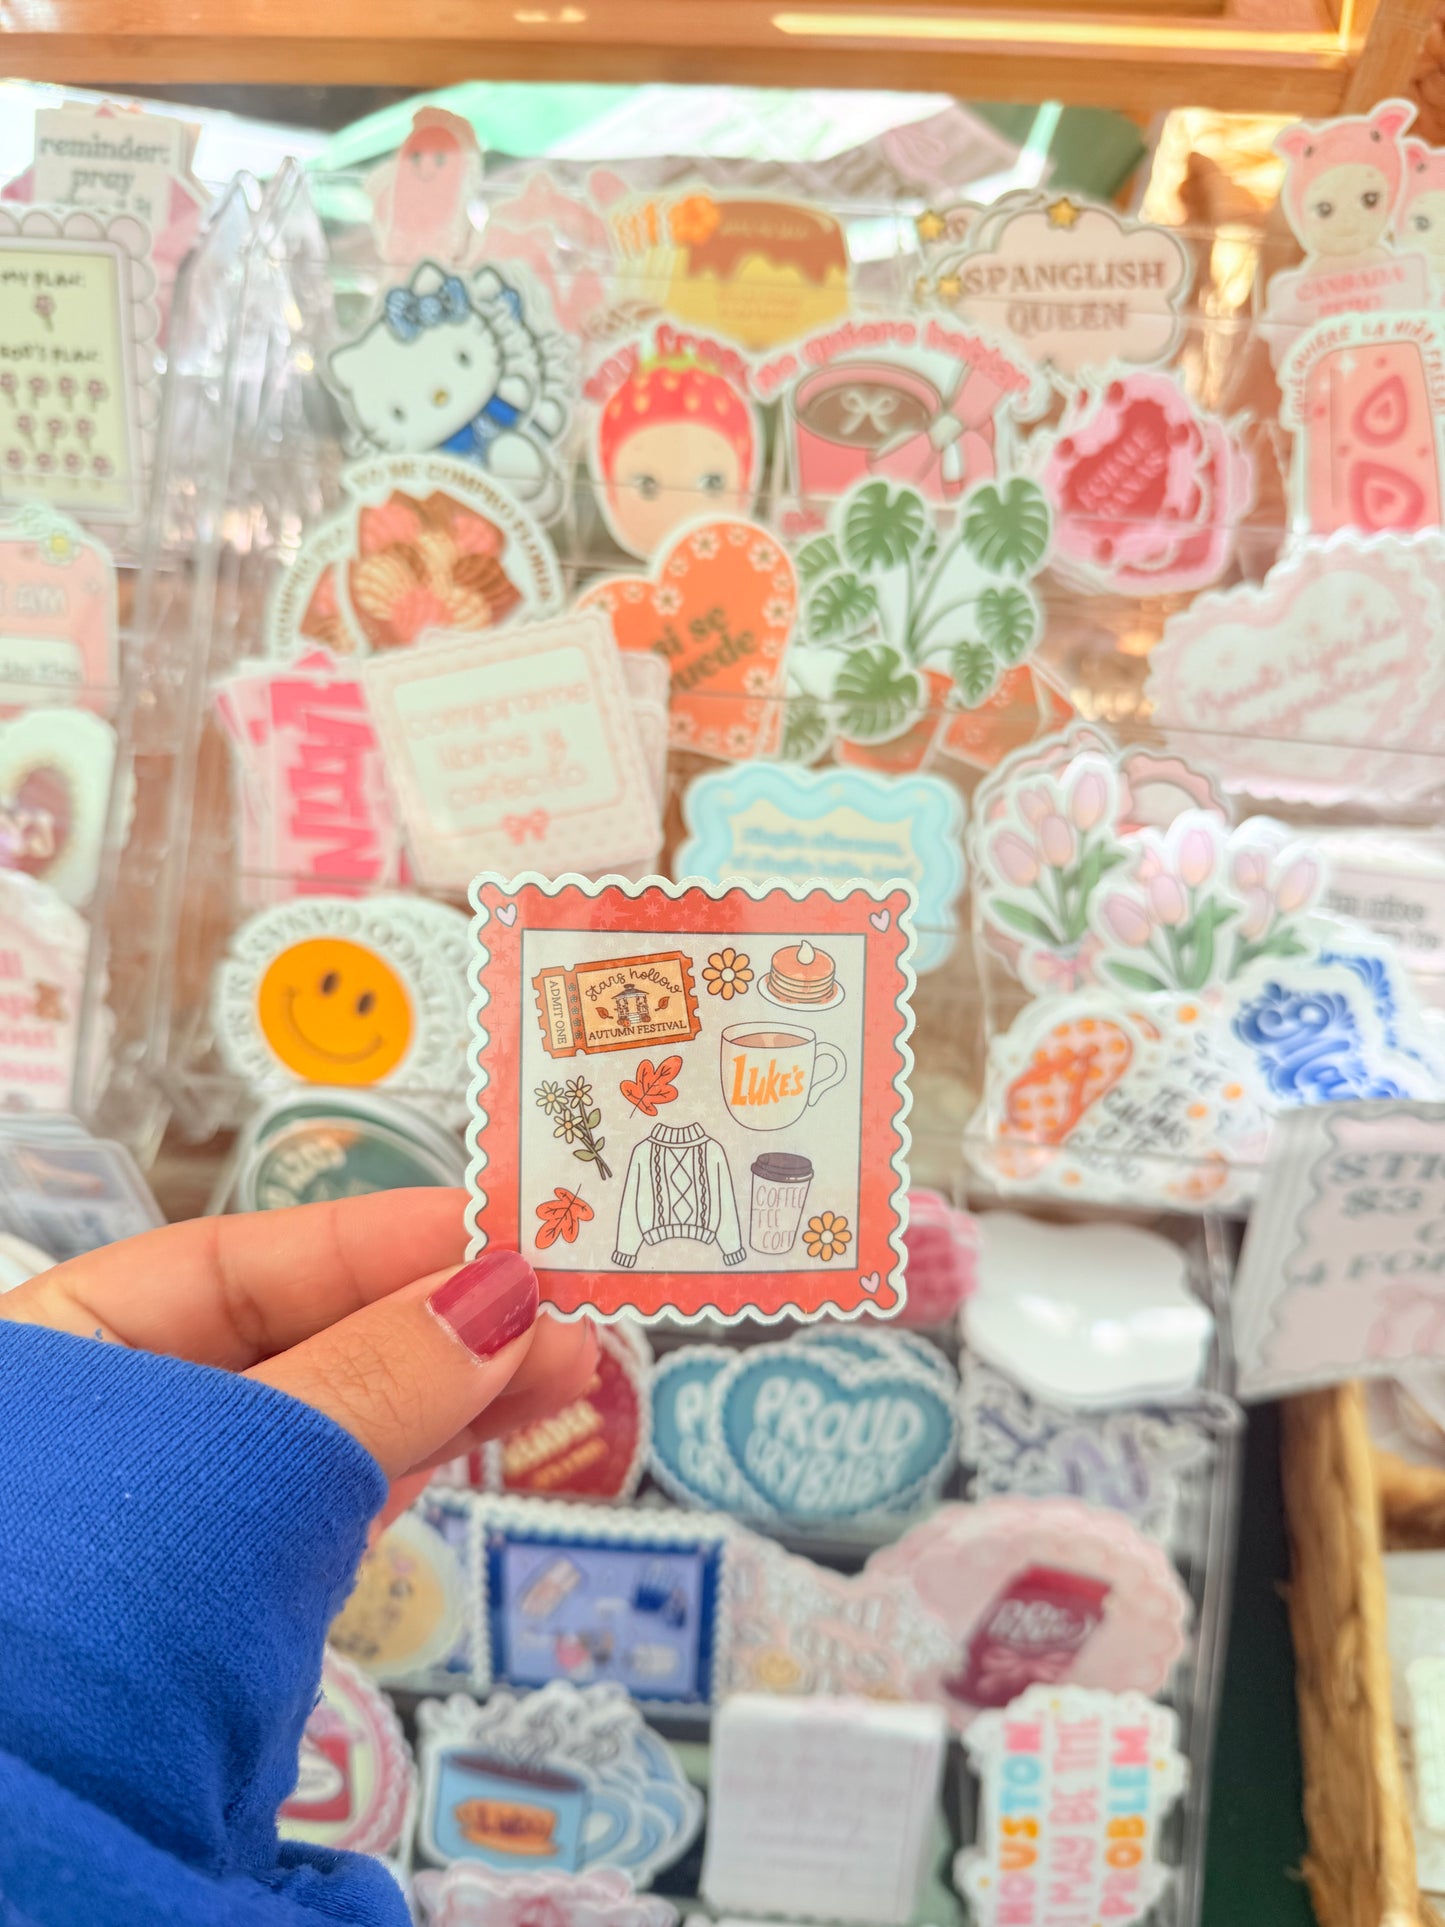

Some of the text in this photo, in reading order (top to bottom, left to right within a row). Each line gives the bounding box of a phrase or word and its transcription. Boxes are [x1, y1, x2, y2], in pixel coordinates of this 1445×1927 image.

[39, 132, 171, 164] reminder:
[70, 168, 137, 200] pray
[961, 258, 1166, 294] SPANGLISH
[1006, 302, 1128, 338] QUEEN
[1361, 322, 1386, 338] LA
[804, 320, 917, 365] quiero
[688, 606, 729, 643] se
[669, 630, 757, 694] uede
[268, 681, 384, 897] LATIN
[585, 968, 682, 1001] stars hollow
[549, 980, 568, 1044] ADMIT ONE
[588, 1020, 687, 1040] AUTUMN FESTIVAL
[1329, 1152, 1445, 1184] STI
[756, 1185, 806, 1209] COFFEE
[752, 1375, 926, 1456] PROUD
[745, 1426, 902, 1508] CRYBABY
